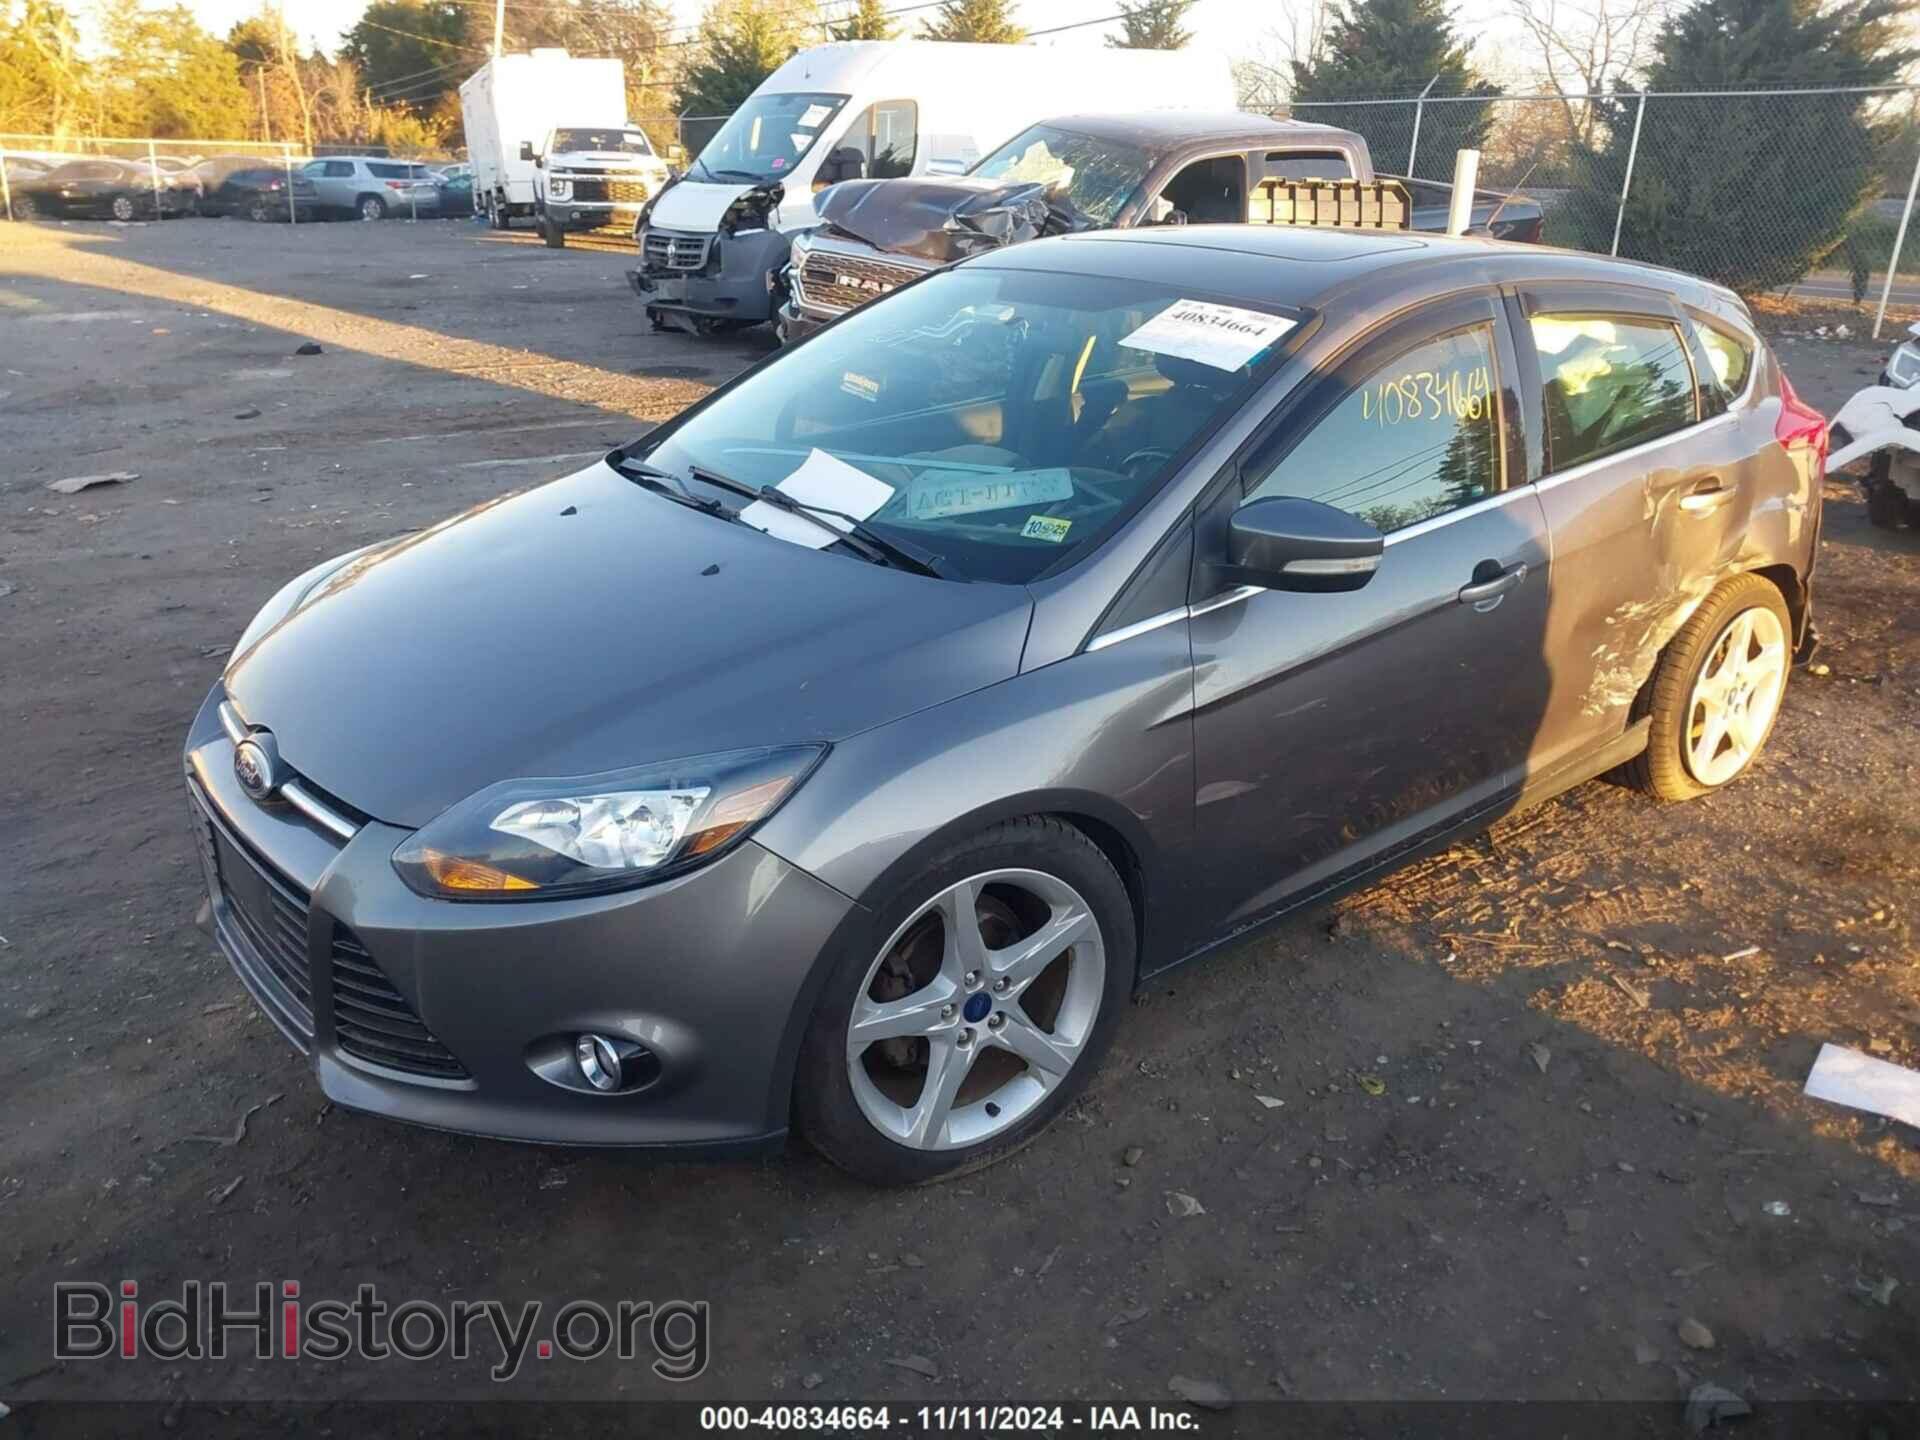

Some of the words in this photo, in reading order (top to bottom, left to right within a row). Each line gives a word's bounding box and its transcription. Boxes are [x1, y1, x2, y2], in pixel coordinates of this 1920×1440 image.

[1171, 309, 1268, 337] 40834664
[1362, 366, 1492, 429] 40834664
[1027, 519, 1042, 534] 10
